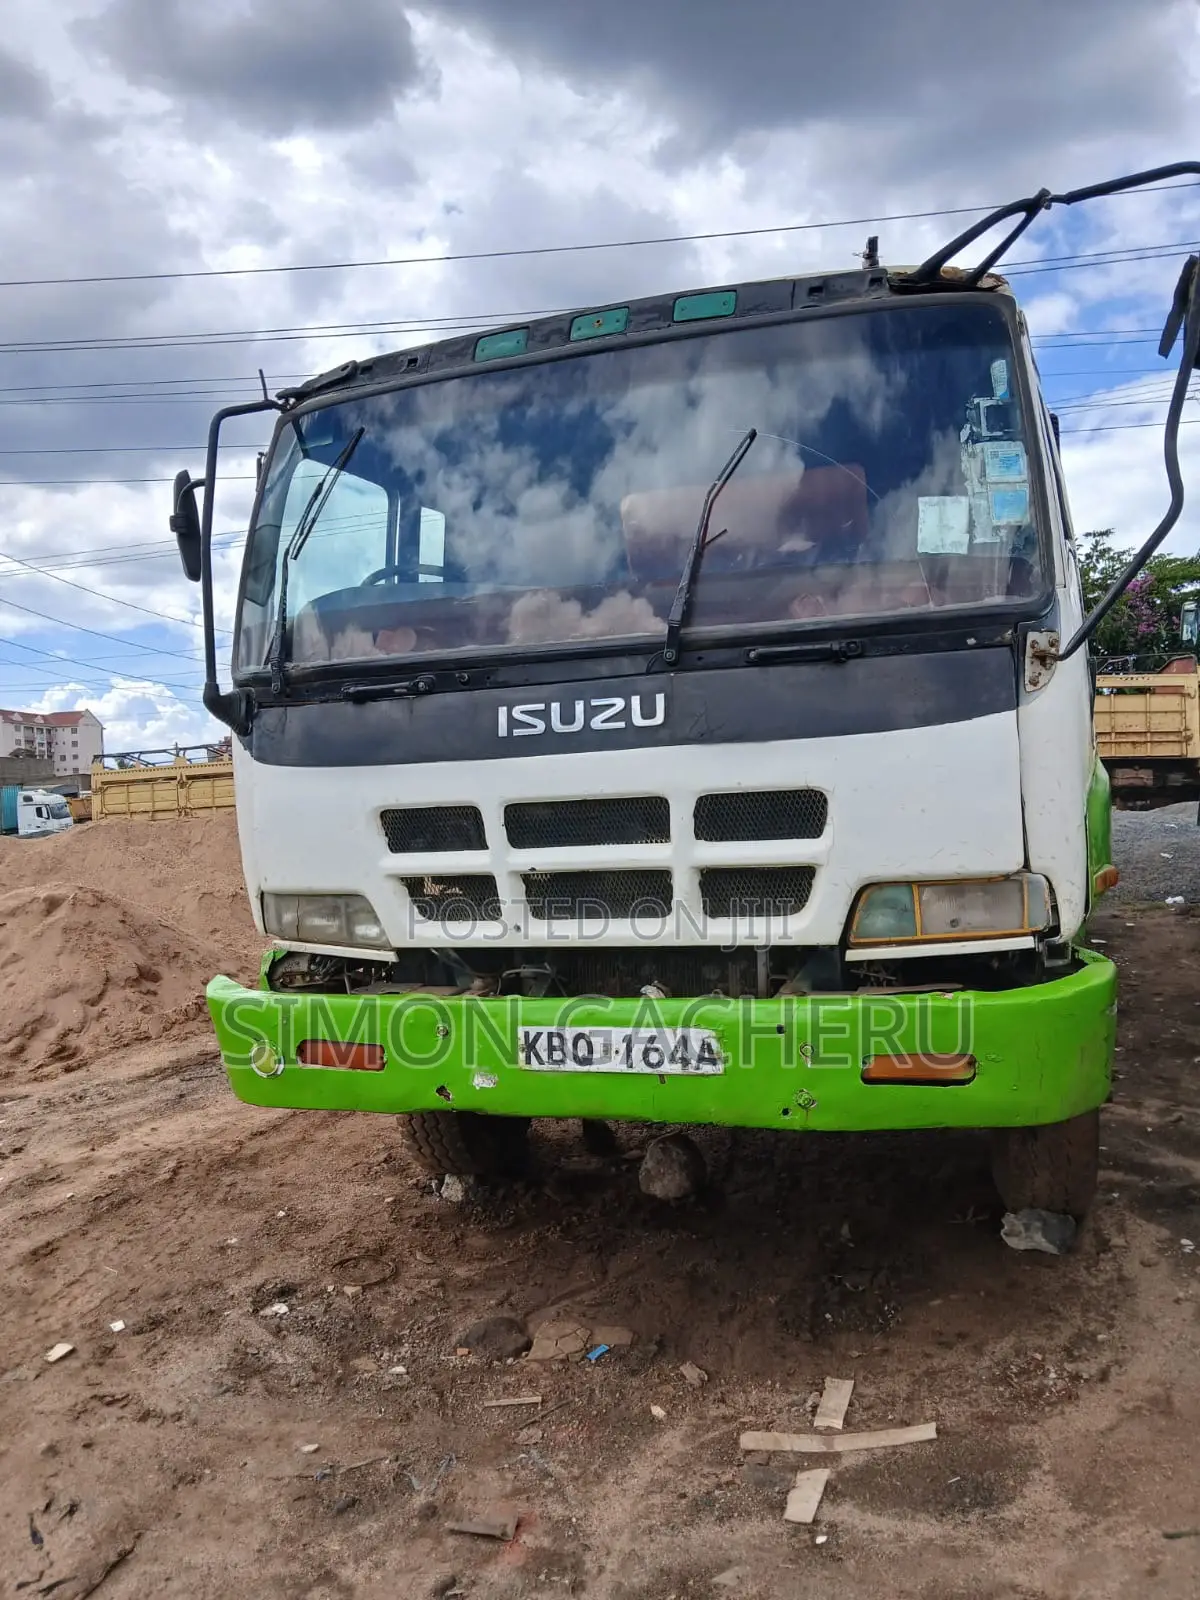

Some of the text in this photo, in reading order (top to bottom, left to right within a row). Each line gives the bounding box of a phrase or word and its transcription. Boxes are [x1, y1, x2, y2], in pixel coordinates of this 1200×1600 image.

[497, 693, 665, 737] ISUZU
[523, 1030, 719, 1070] KBQ 164A
